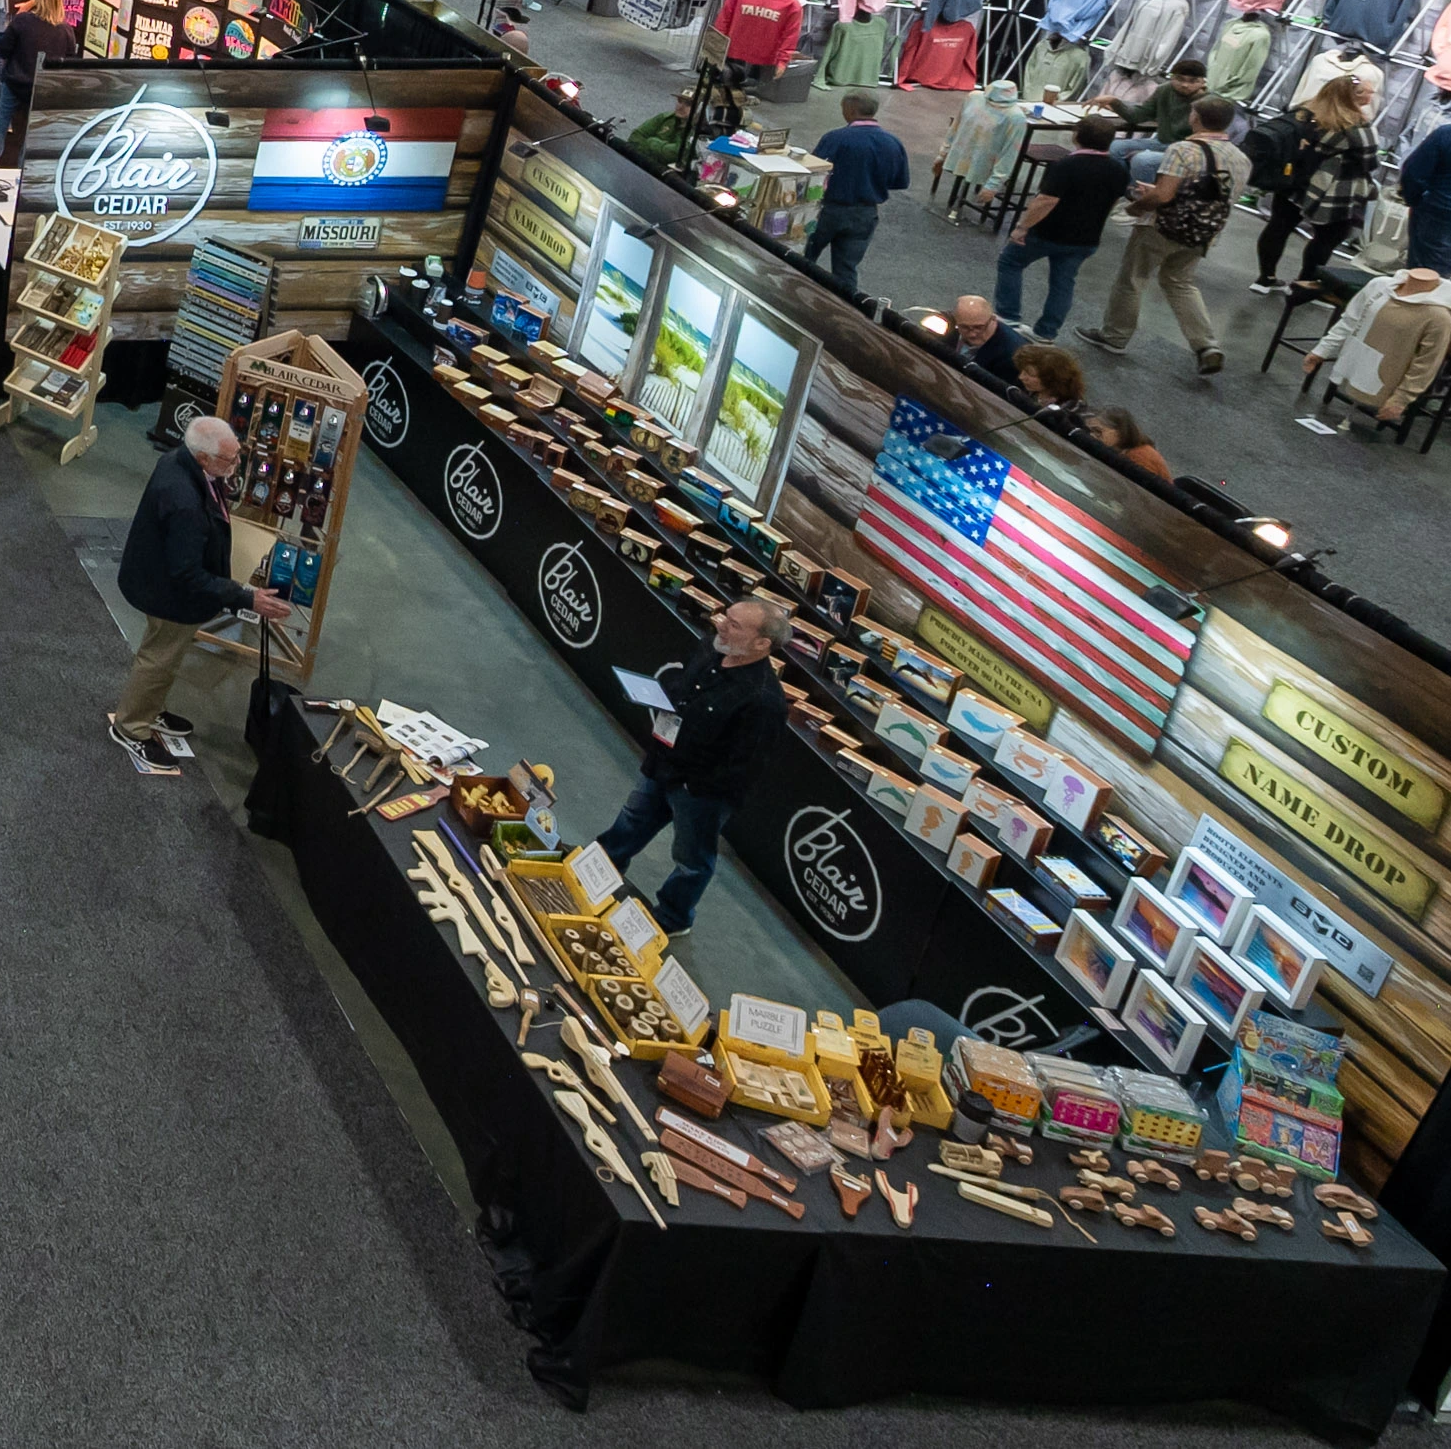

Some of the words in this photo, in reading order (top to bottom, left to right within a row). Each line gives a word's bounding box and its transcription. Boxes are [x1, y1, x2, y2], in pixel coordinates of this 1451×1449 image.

[135, 14, 174, 38] MIRAMAR
[740, 5, 782, 22] TAHOE
[133, 29, 172, 49] BEACH
[72, 95, 198, 198] Blair
[94, 195, 169, 216] CEDAR
[532, 166, 573, 203] CUSTOM
[103, 220, 124, 231] EST.
[126, 219, 152, 231] 1930
[303, 224, 377, 242] MISSOURI
[513, 208, 541, 237] NAME
[540, 230, 567, 258] DROP
[264, 365, 300, 384] BLAIR
[301, 374, 344, 396] CEDAR
[368, 356, 403, 424] Blair
[369, 405, 393, 434] CEDAR
[450, 440, 495, 515] Blair
[455, 492, 483, 524] CEDAR
[544, 539, 593, 622] Blair
[550, 593, 580, 632] CEDAR
[929, 615, 966, 645] PROUDLY
[967, 644, 993, 669] MADE
[992, 663, 1004, 678] IN
[1004, 672, 1023, 692] THE
[1022, 687, 1042, 708] USA
[940, 636, 956, 653] FOR
[955, 649, 980, 673] OVER
[980, 667, 994, 682] 90
[993, 679, 1022, 708] YEARS
[1295, 709, 1415, 799] CUSTOM
[1242, 763, 1320, 825] NAME
[1321, 815, 1409, 886] DROP
[794, 808, 868, 910] Blair
[1199, 843, 1245, 885] PRODUCED
[1202, 835, 1248, 873] DESIGNED
[1247, 869, 1266, 890] AND
[1206, 826, 1239, 853] BOOTH
[1238, 849, 1283, 891] ELEMENTS
[804, 867, 848, 921] CEDAR
[748, 1006, 786, 1025] MARBLE
[750, 1019, 784, 1036] PUZZLE
